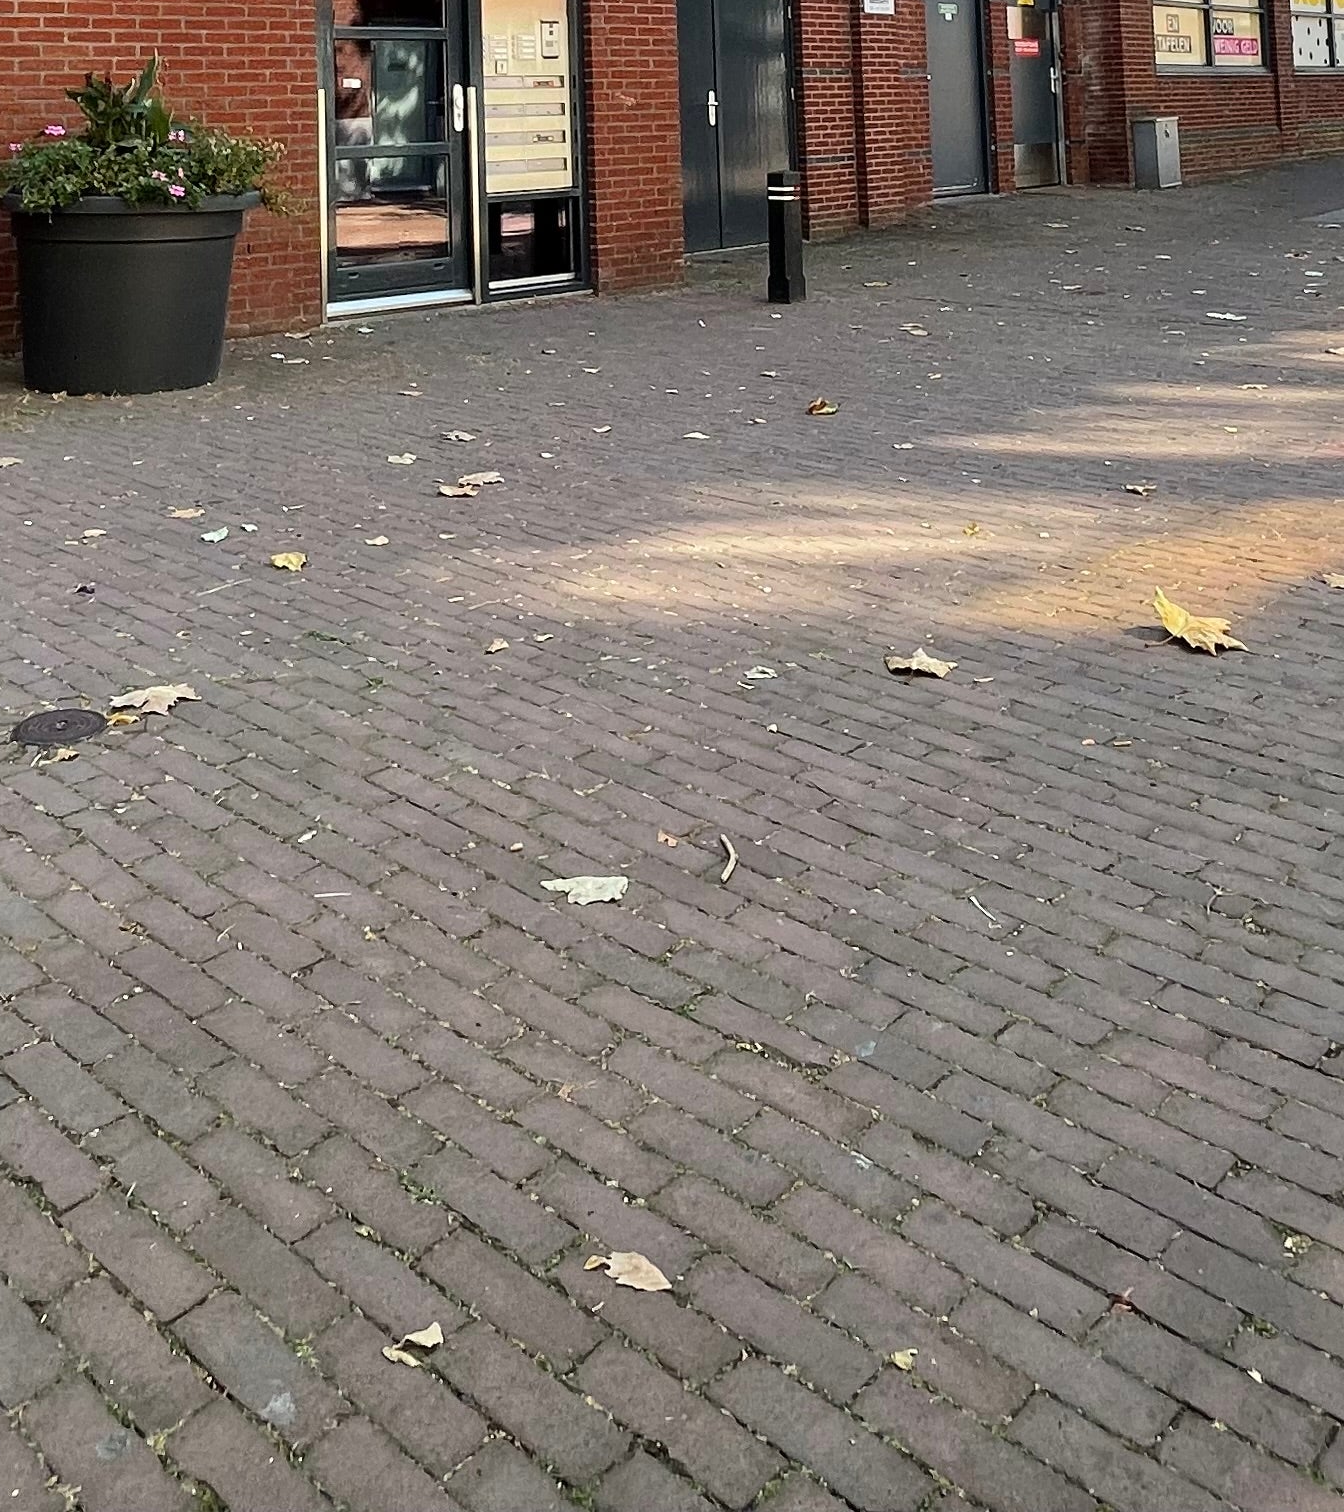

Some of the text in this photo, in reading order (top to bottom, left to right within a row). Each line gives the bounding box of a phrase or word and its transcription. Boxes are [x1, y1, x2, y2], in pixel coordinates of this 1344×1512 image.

[1167, 15, 1178, 31] EN
[1156, 36, 1190, 52] TAFELEN
[1240, 39, 1258, 54] GELD
